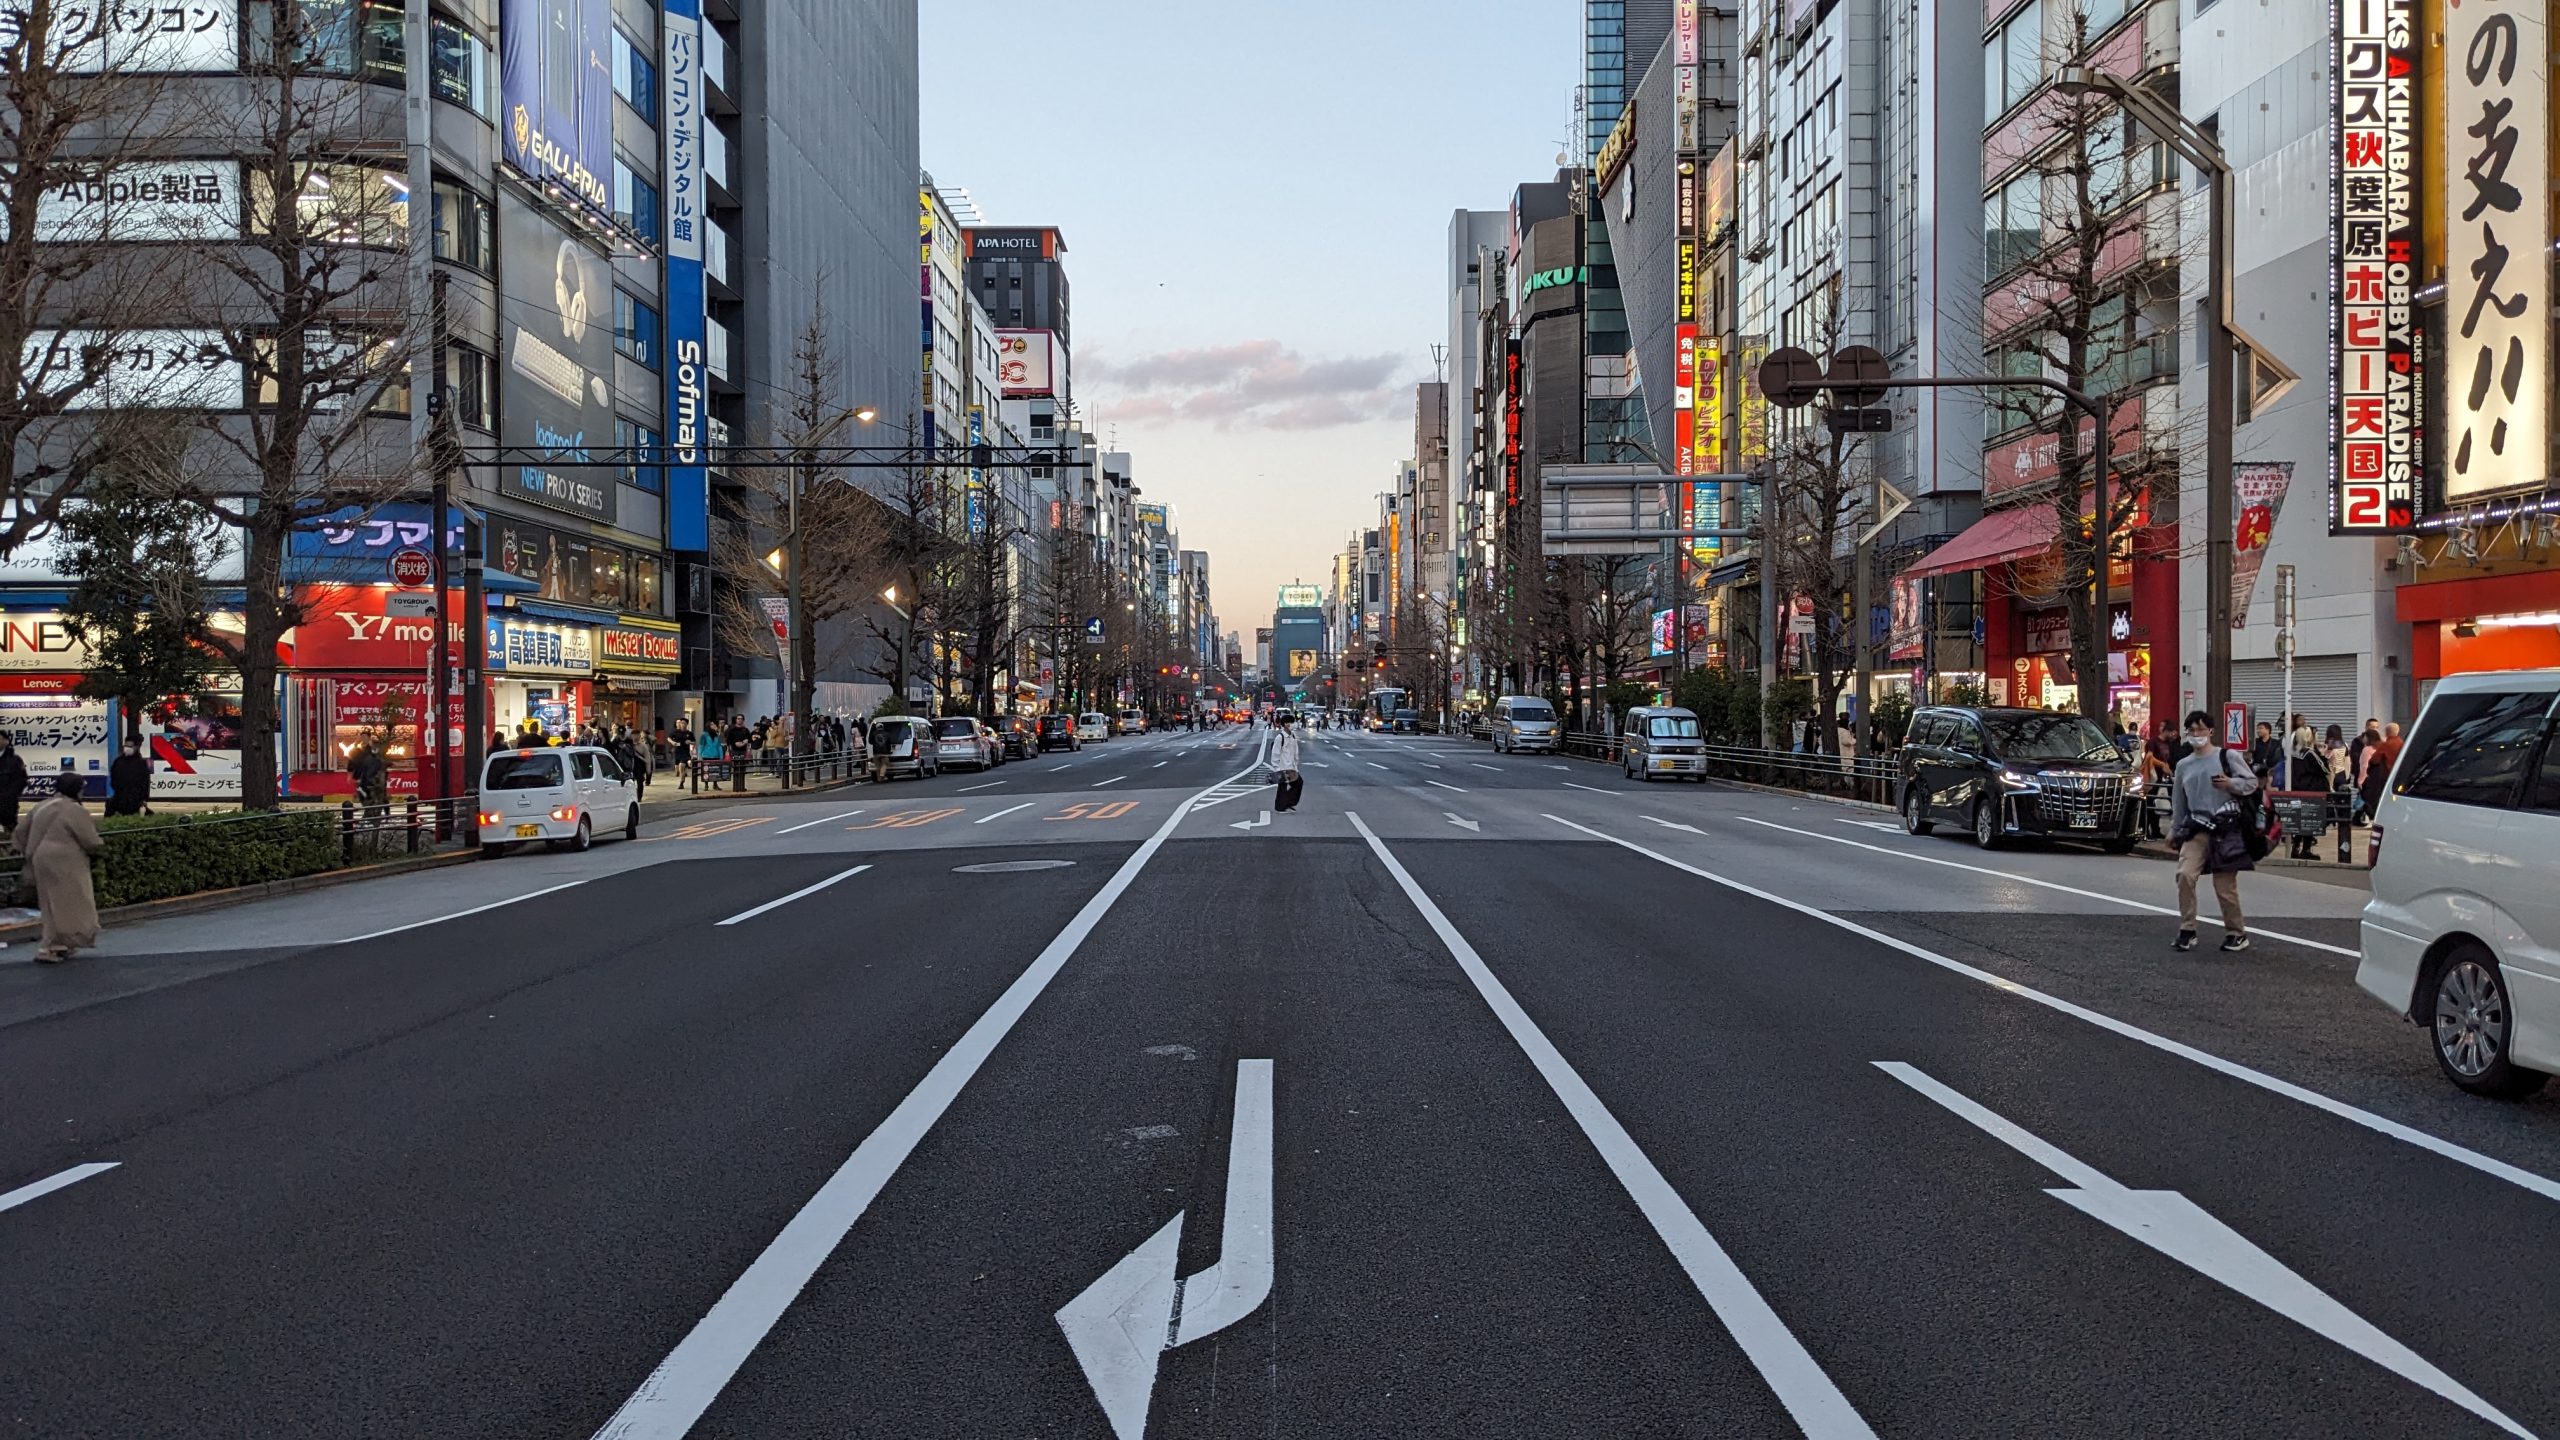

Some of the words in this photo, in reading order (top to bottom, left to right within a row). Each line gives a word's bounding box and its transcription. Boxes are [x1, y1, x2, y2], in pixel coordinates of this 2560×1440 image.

[671, 34, 693, 243] パソコン・デジタル館
[2388, 57, 2410, 232] AKIHABARA
[531, 130, 606, 207] GALLERIA
[976, 239, 1000, 248] APA
[1001, 238, 1038, 248] HOTEL
[2388, 240, 2410, 346] HOBBY
[673, 339, 700, 464] Sofmap
[2414, 366, 2422, 427] AKIHABARA
[535, 420, 573, 458] logicool
[2388, 353, 2410, 500] PARADISE
[2414, 430, 2422, 466] HOBBY
[521, 464, 545, 493] NEW
[547, 473, 567, 499] PRO
[568, 481, 575, 503] X
[576, 484, 603, 511] SERIES
[397, 561, 428, 576] 消火栓
[508, 628, 562, 667] 高額買取
[604, 630, 642, 658] Mister
[643, 632, 678, 660] Donut
[566, 687, 577, 710] TAX
[1042, 801, 1140, 820] 50
